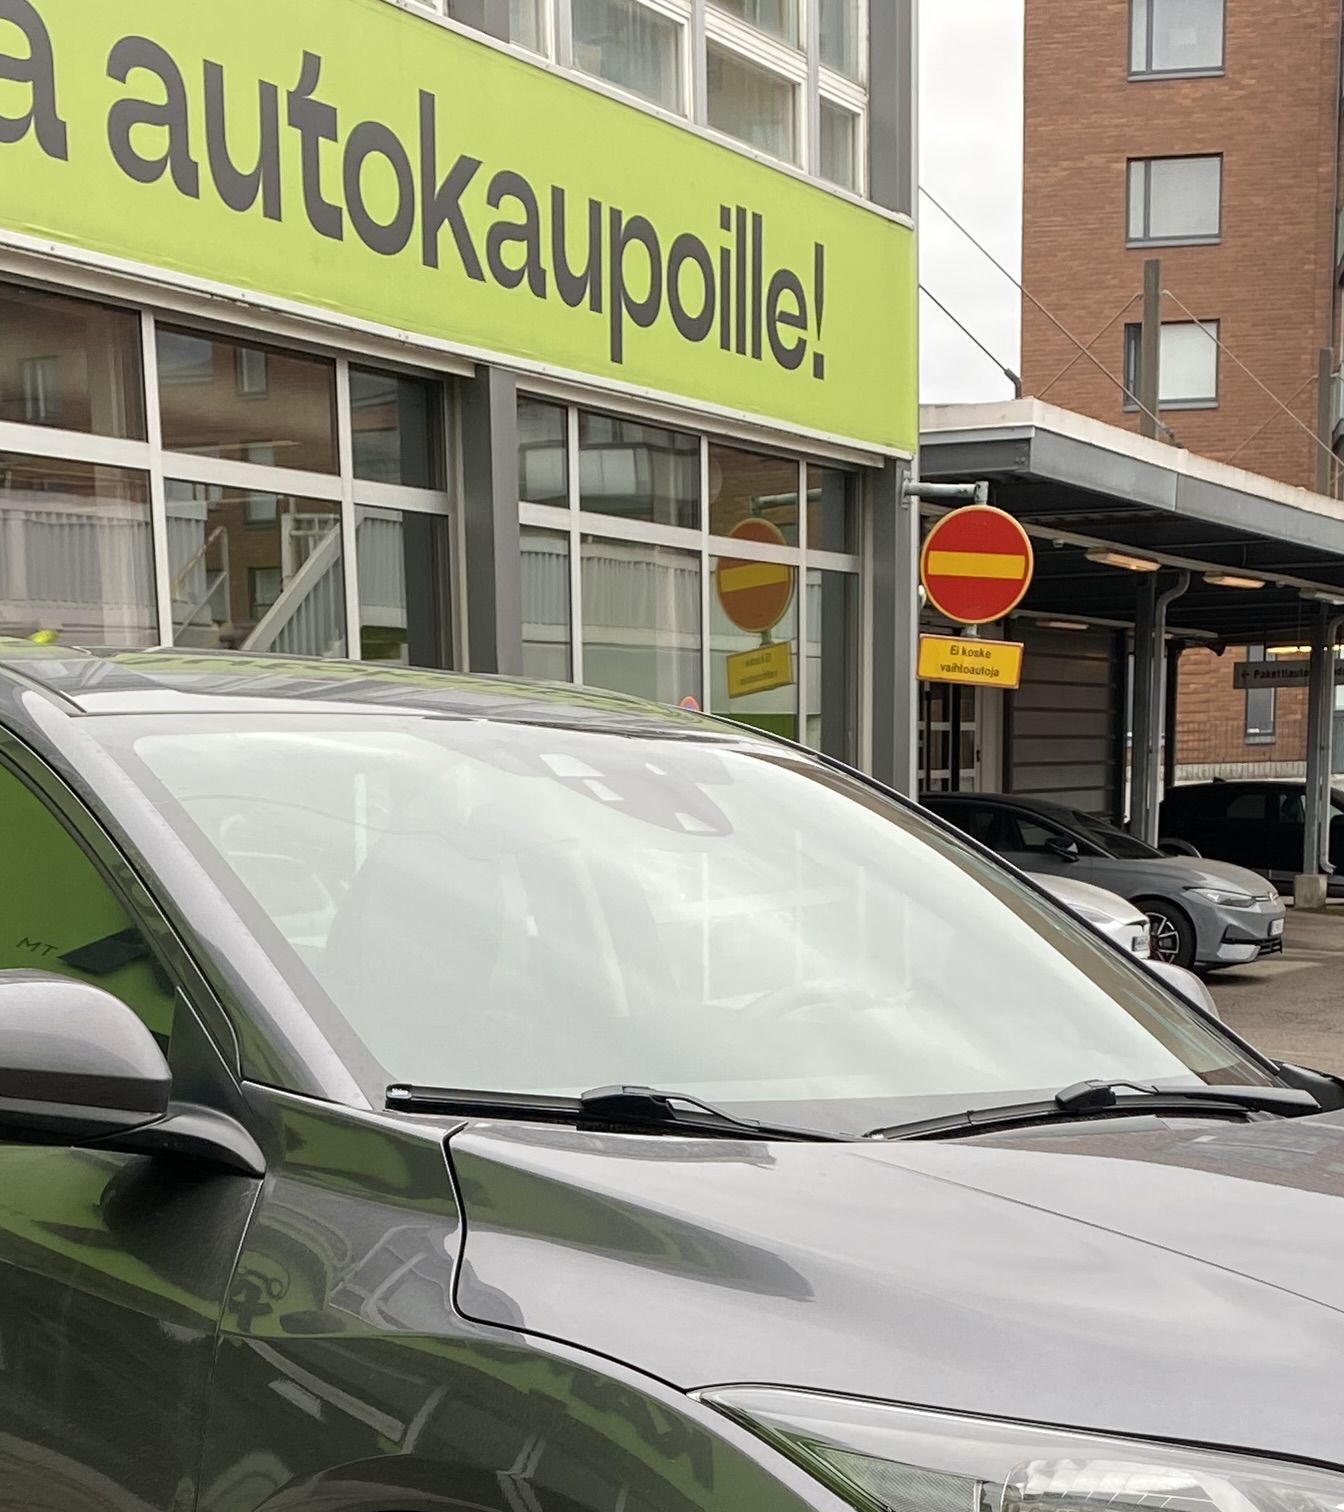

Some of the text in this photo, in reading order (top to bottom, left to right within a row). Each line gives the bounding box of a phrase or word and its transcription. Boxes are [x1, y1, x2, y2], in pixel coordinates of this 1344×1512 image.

[106, 35, 825, 380] autokaupoille!
[949, 644, 992, 659] Ei koske
[939, 662, 1000, 678] vaihtoautoja
